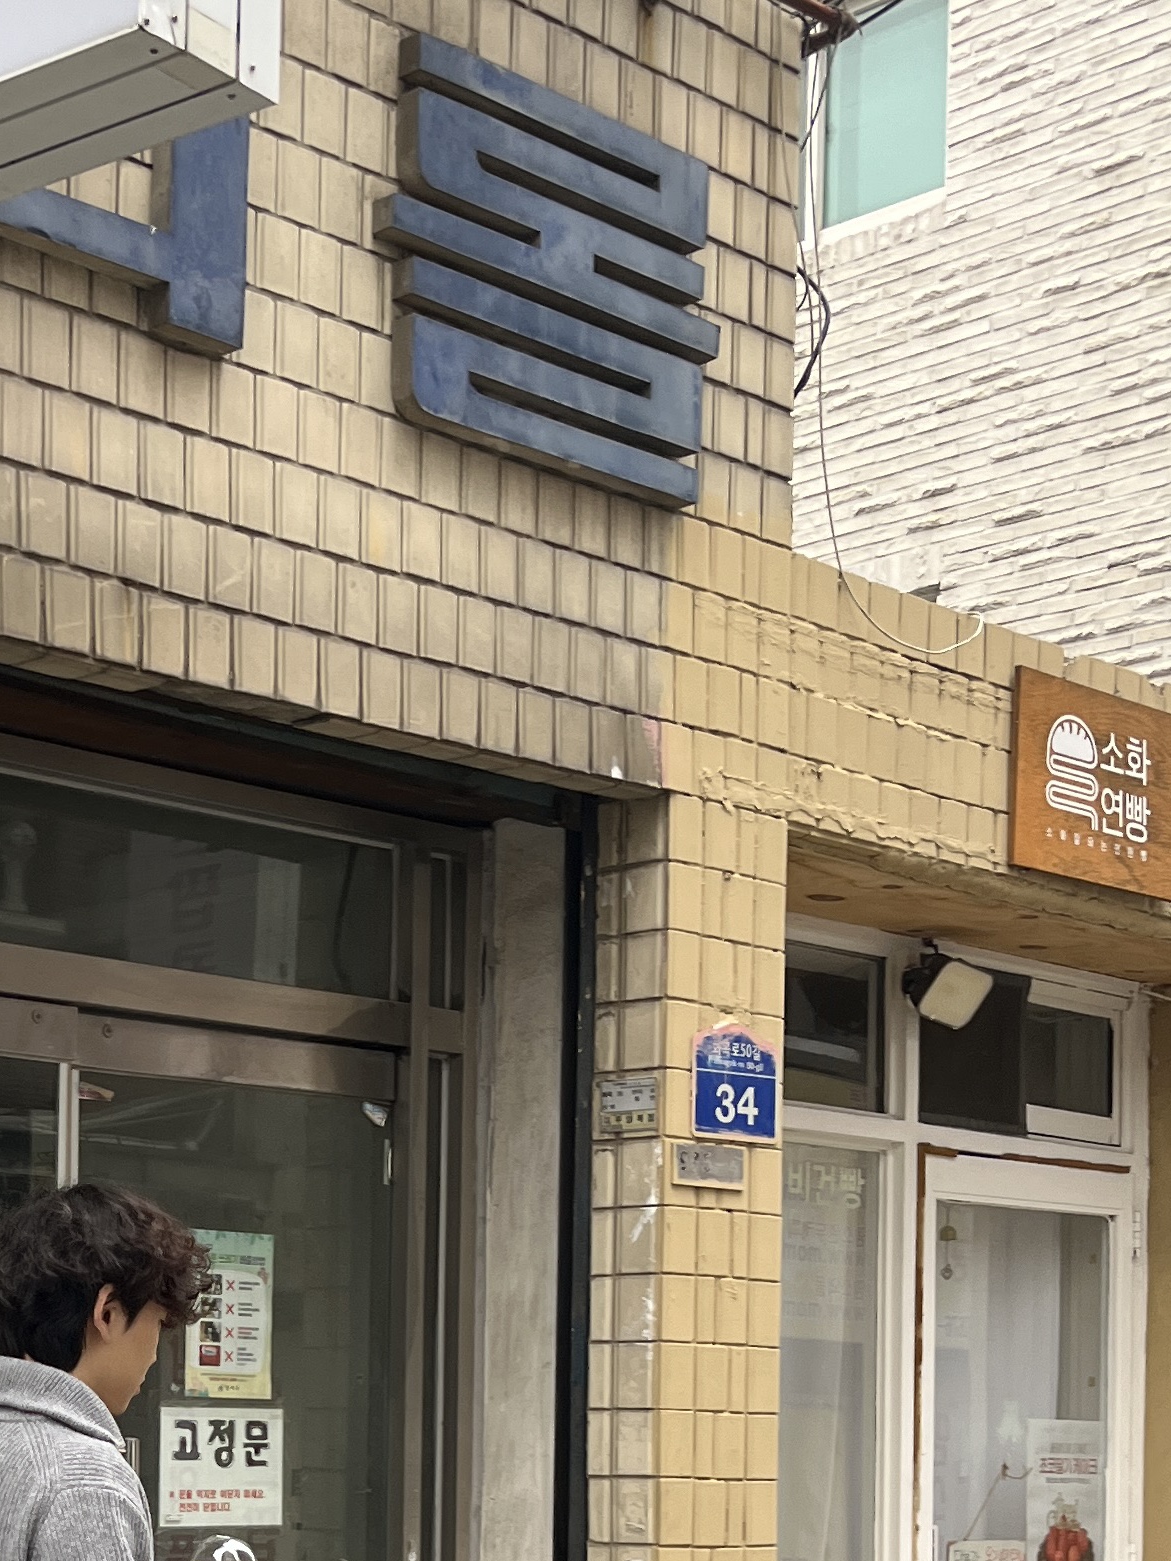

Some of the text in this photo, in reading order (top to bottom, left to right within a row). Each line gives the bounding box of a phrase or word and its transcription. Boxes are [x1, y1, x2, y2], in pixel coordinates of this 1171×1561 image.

[1100, 732, 1152, 786] 소화
[1101, 787, 1151, 844] 연빵
[714, 1083, 759, 1126] 34
[172, 1419, 269, 1468] 고정문
